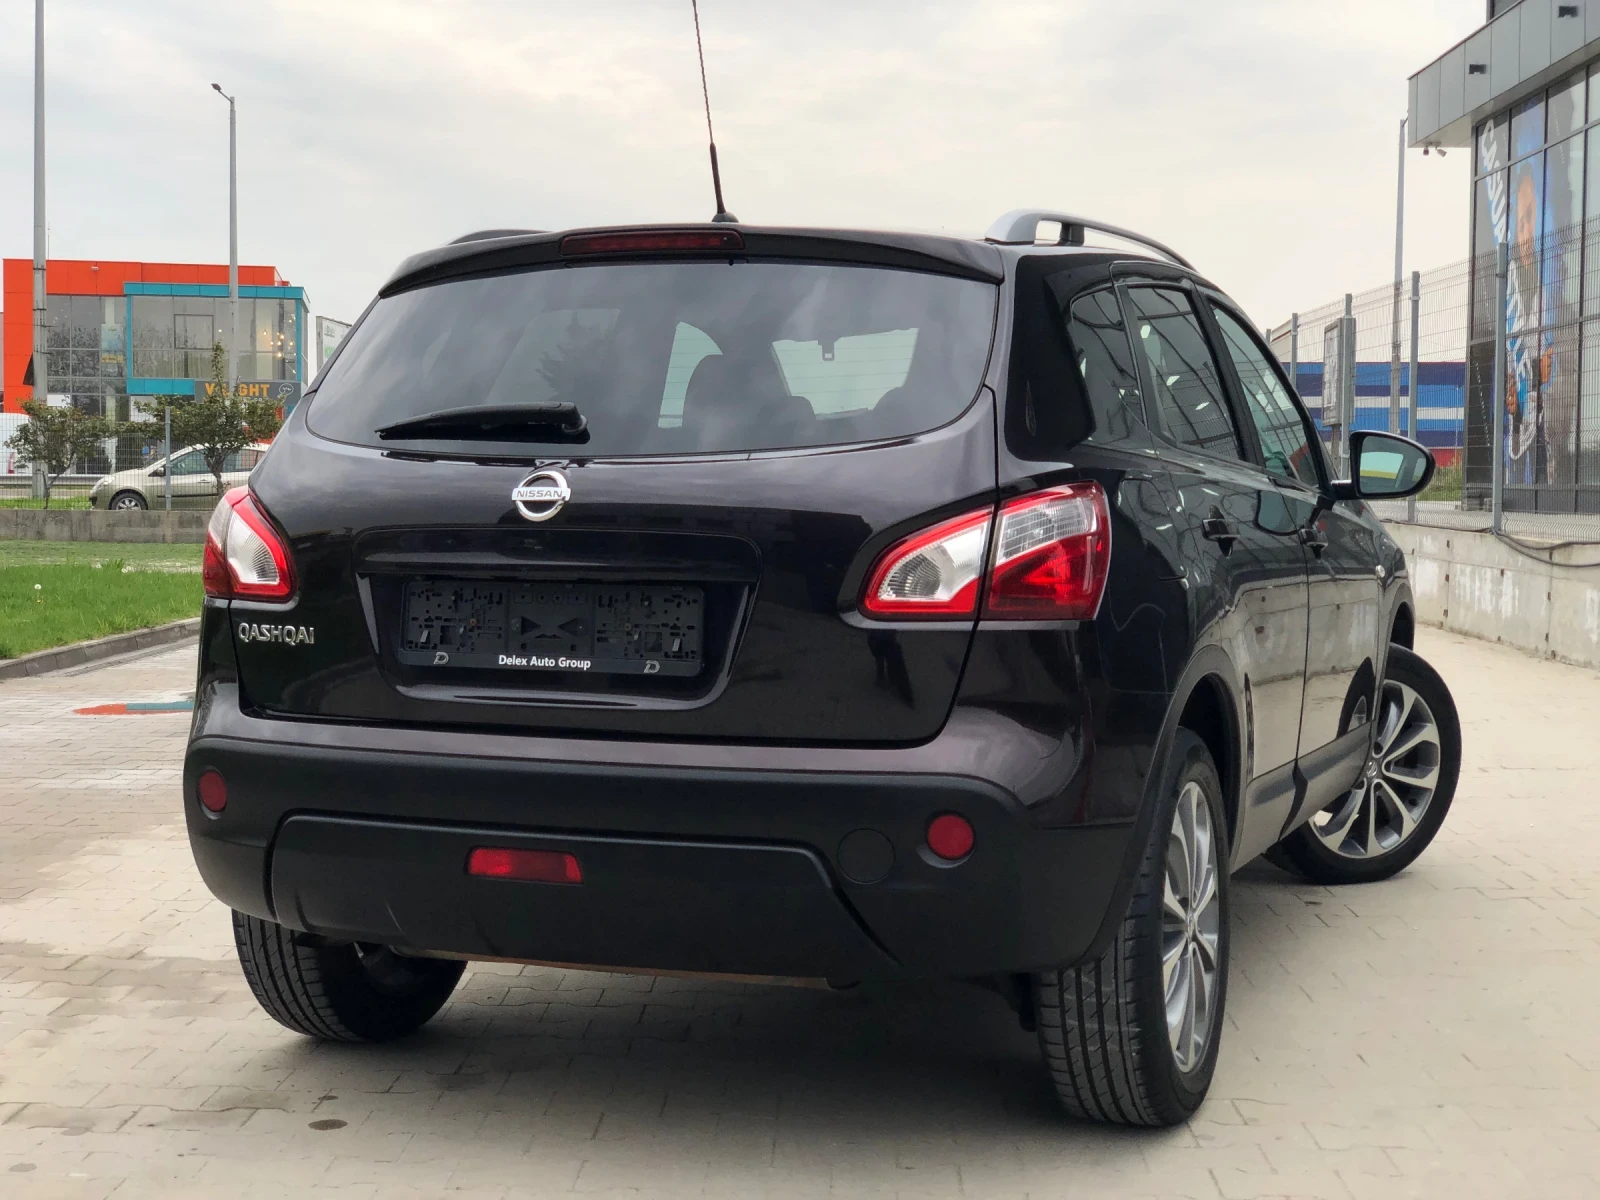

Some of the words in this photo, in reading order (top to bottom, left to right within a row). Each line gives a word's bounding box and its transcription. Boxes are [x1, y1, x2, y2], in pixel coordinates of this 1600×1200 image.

[516, 489, 563, 498] NISSAN
[238, 622, 315, 645] QASHQAI
[498, 654, 527, 667] Delex
[530, 656, 555, 667] Auto
[558, 657, 591, 671] Group
